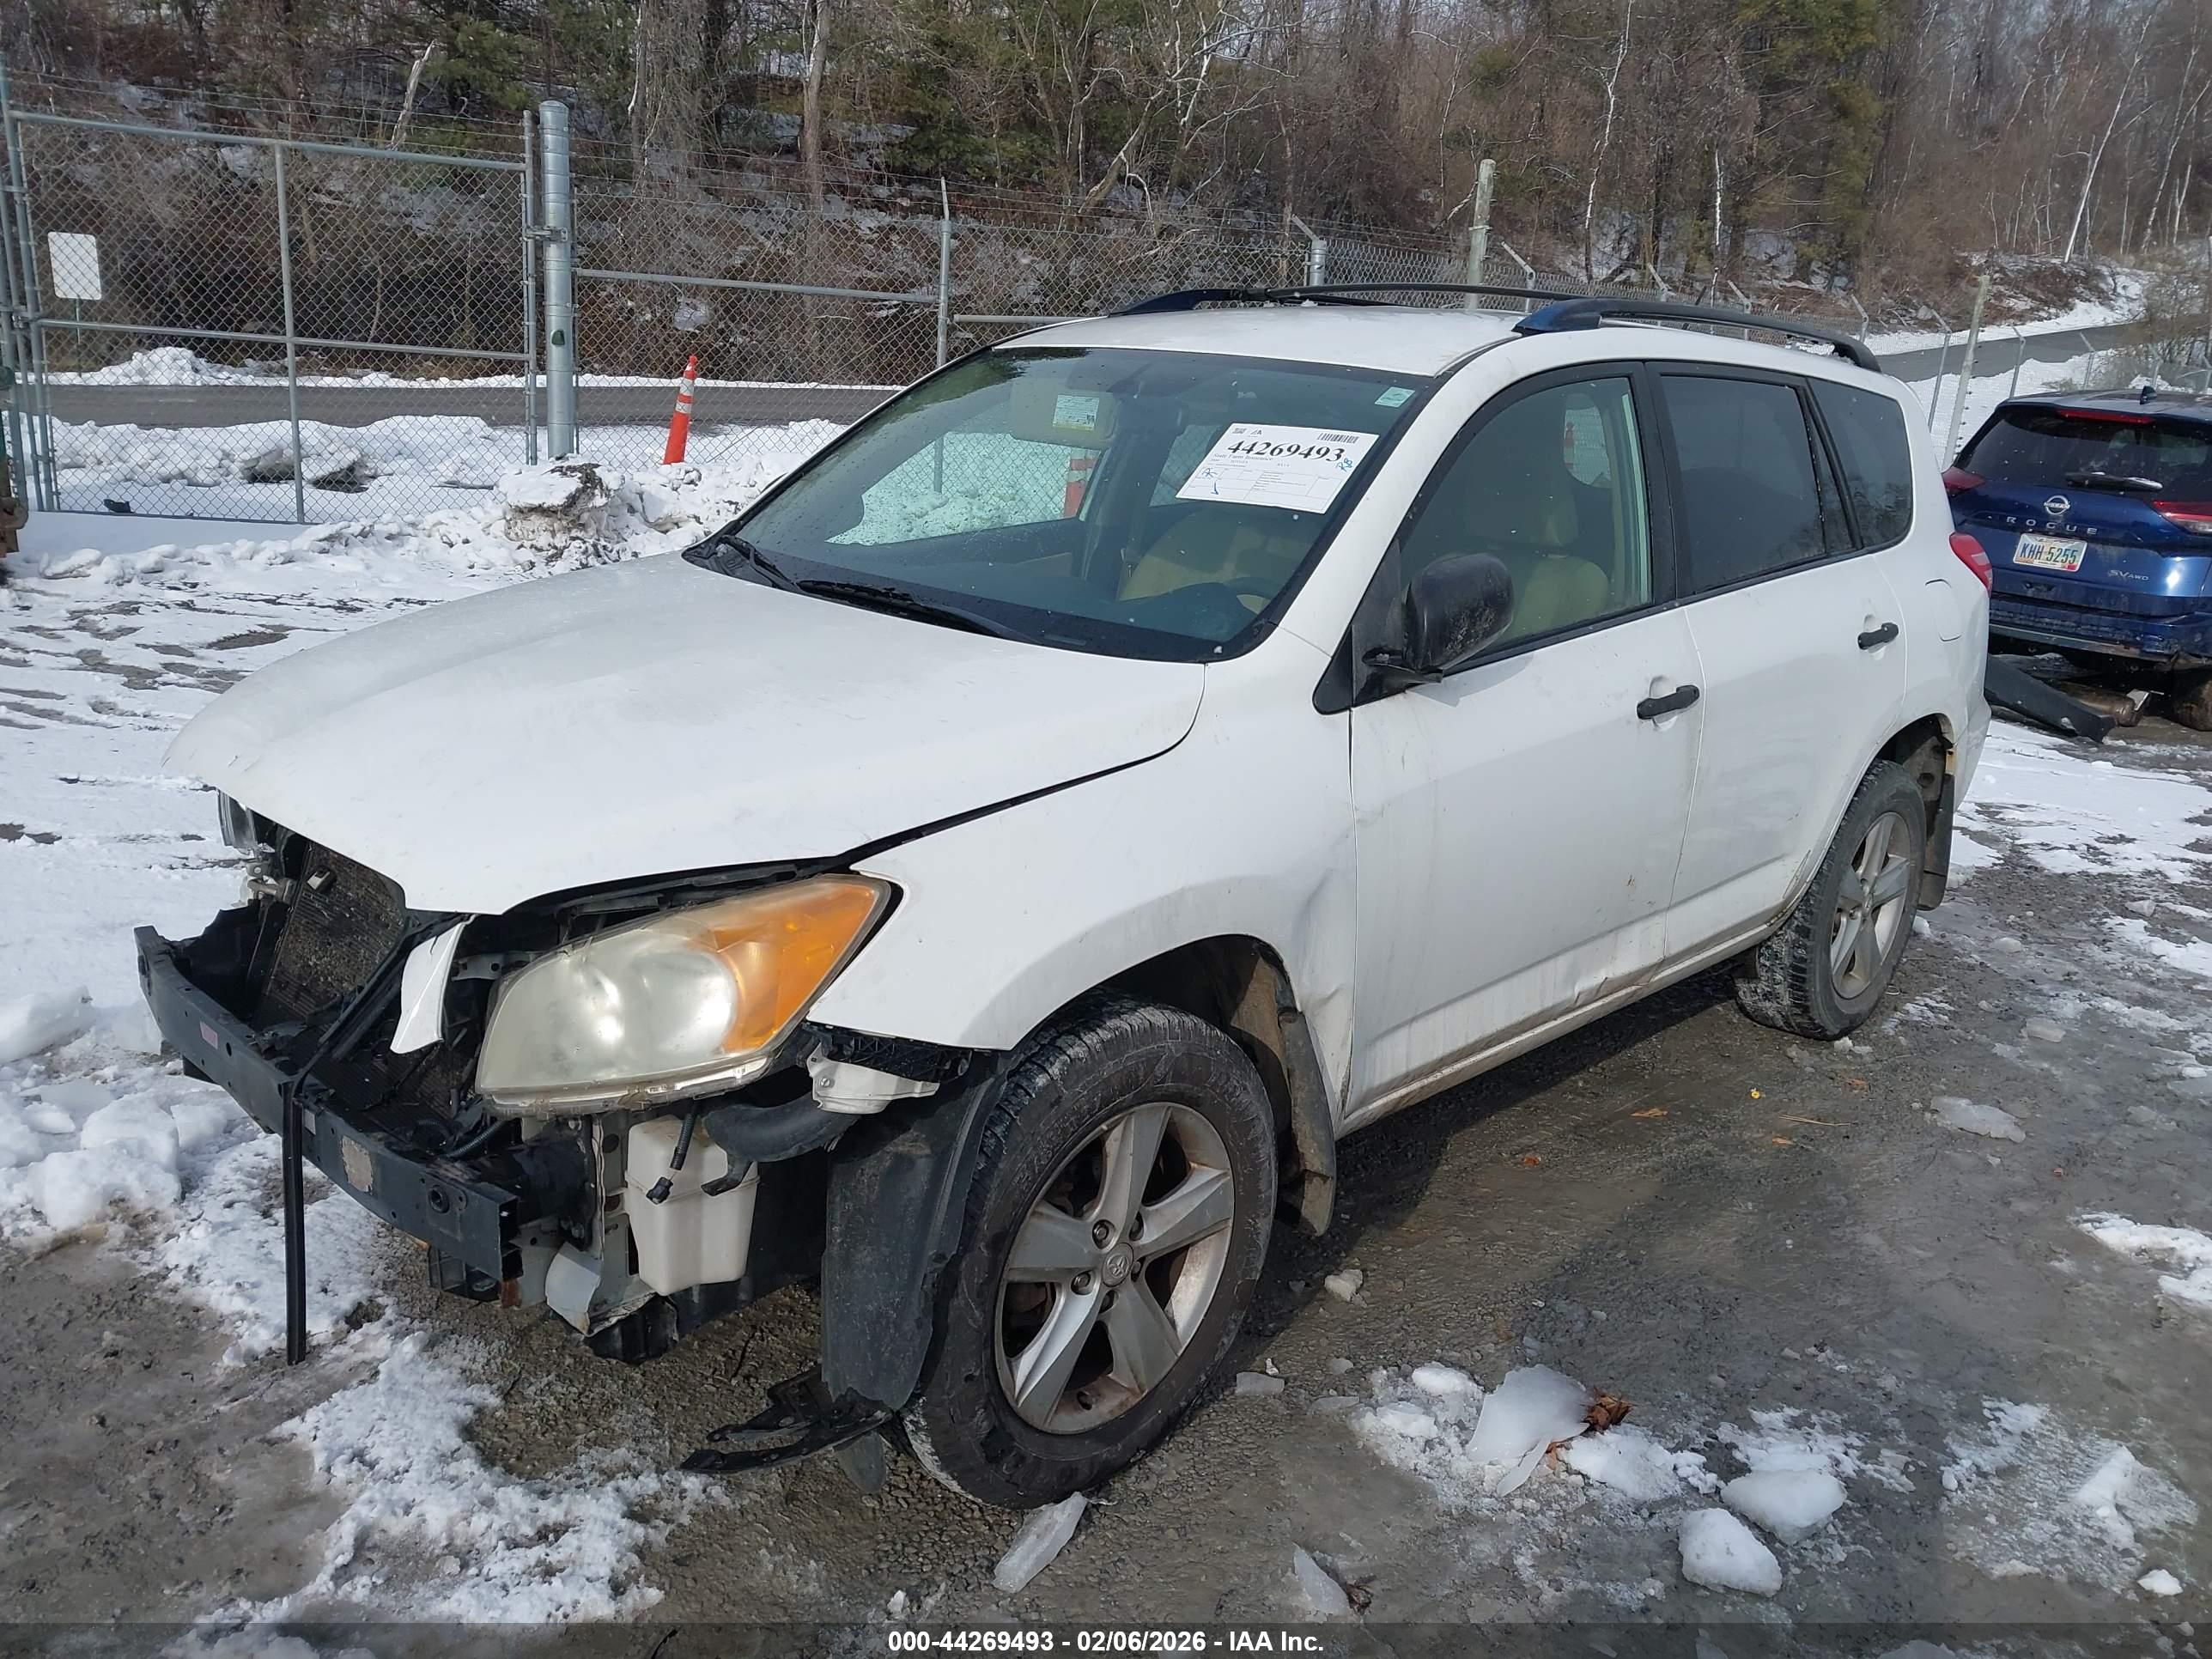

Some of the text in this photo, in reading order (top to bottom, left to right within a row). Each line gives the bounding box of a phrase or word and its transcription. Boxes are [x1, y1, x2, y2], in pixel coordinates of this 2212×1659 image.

[1228, 441, 1345, 462] 44269493
[2006, 515, 2099, 535] ROGUE
[2020, 542, 2079, 564] KHH 5255
